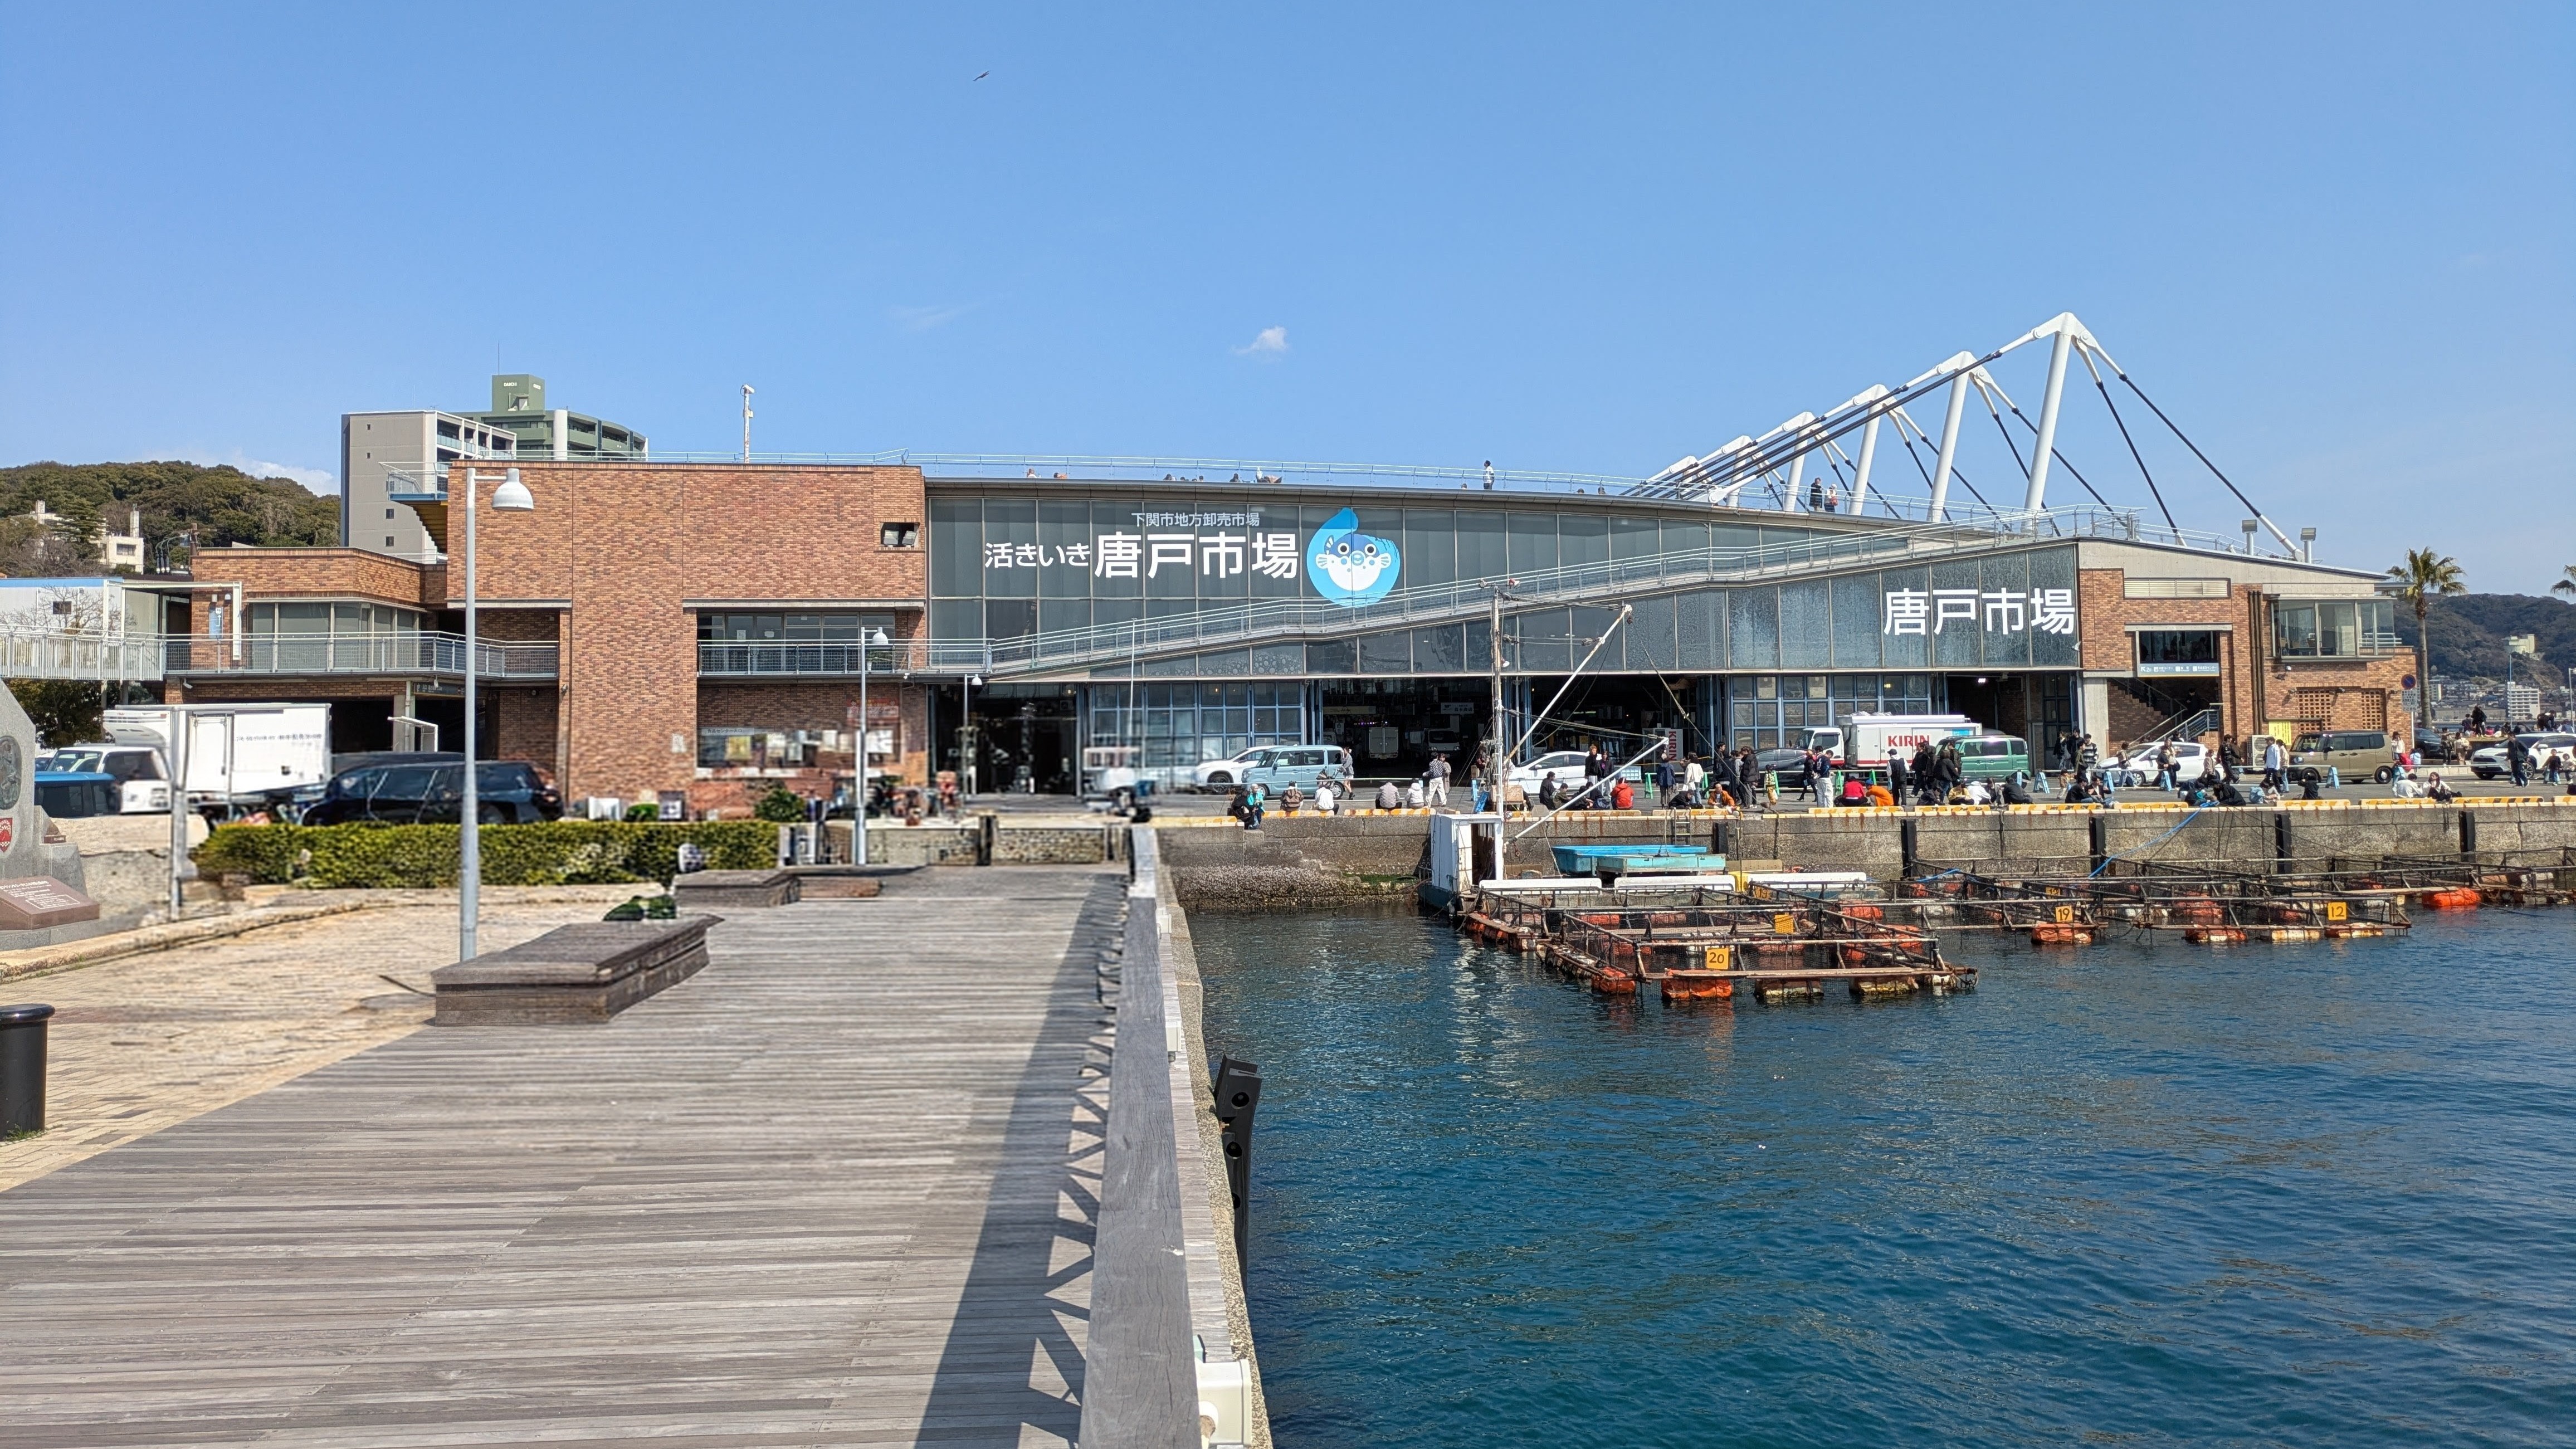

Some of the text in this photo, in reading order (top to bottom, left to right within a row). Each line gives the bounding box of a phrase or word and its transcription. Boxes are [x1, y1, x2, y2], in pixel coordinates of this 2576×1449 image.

[1131, 512, 1260, 526] 下関市地方卸売市場
[984, 531, 1300, 579] 活きいき 唐戸市場
[1884, 588, 2076, 635] 唐戸市場
[1668, 731, 1677, 760] KIRIN
[1888, 735, 1930, 747] KIRIN
[2058, 908, 2070, 920] 19
[2331, 906, 2345, 918] 12
[1709, 952, 1725, 964] 20
